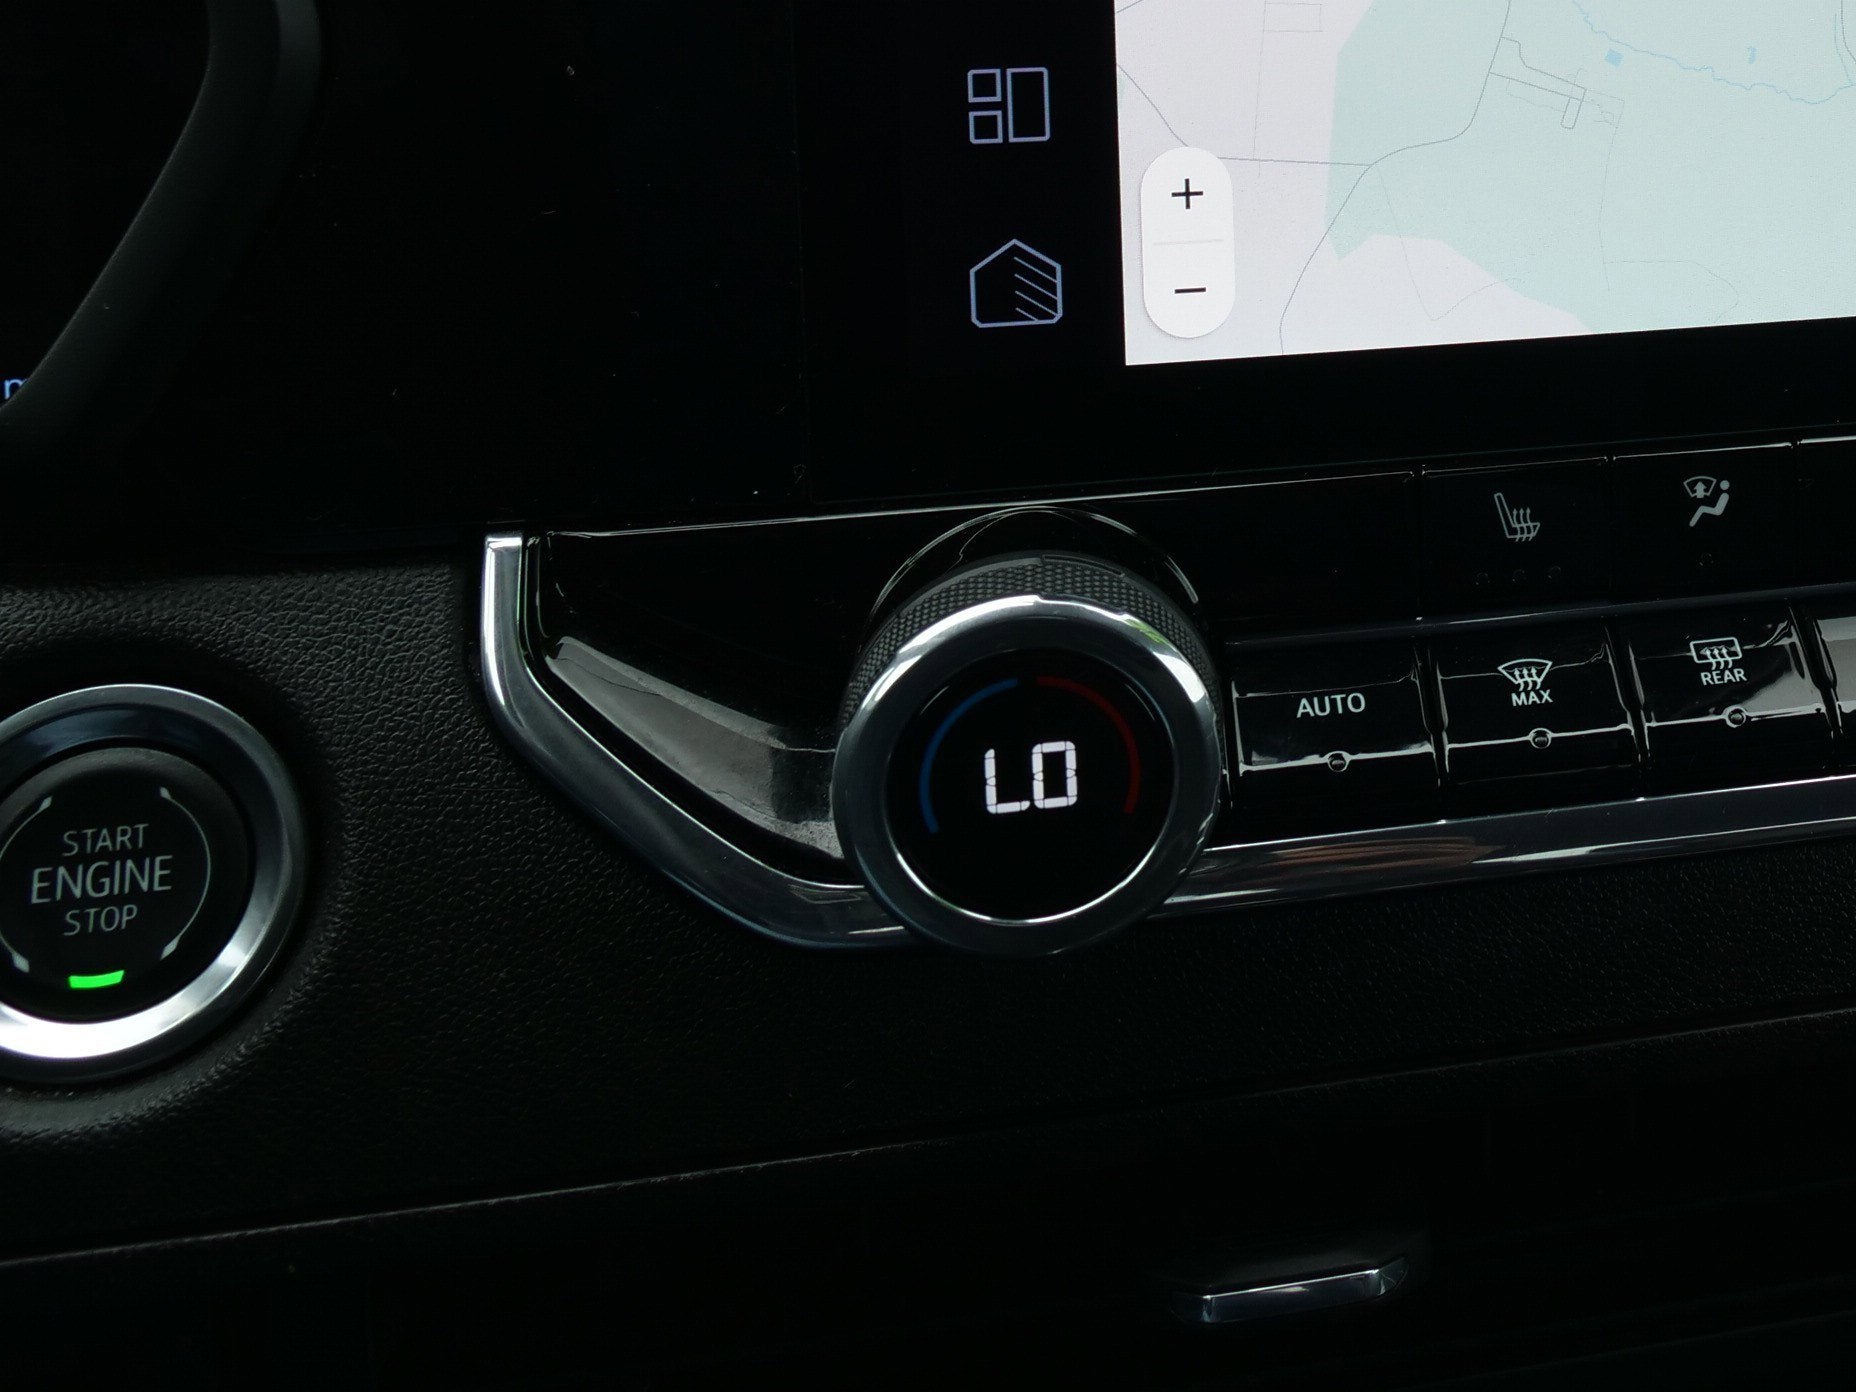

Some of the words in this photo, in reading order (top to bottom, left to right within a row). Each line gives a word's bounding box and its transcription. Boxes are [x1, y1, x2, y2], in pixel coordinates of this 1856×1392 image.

[1700, 668, 1748, 686] REAR
[1296, 691, 1367, 719] AUTO
[1511, 689, 1554, 707] MAX
[61, 822, 150, 857] START
[31, 854, 174, 905] ENGINE
[63, 903, 139, 937] STOP
